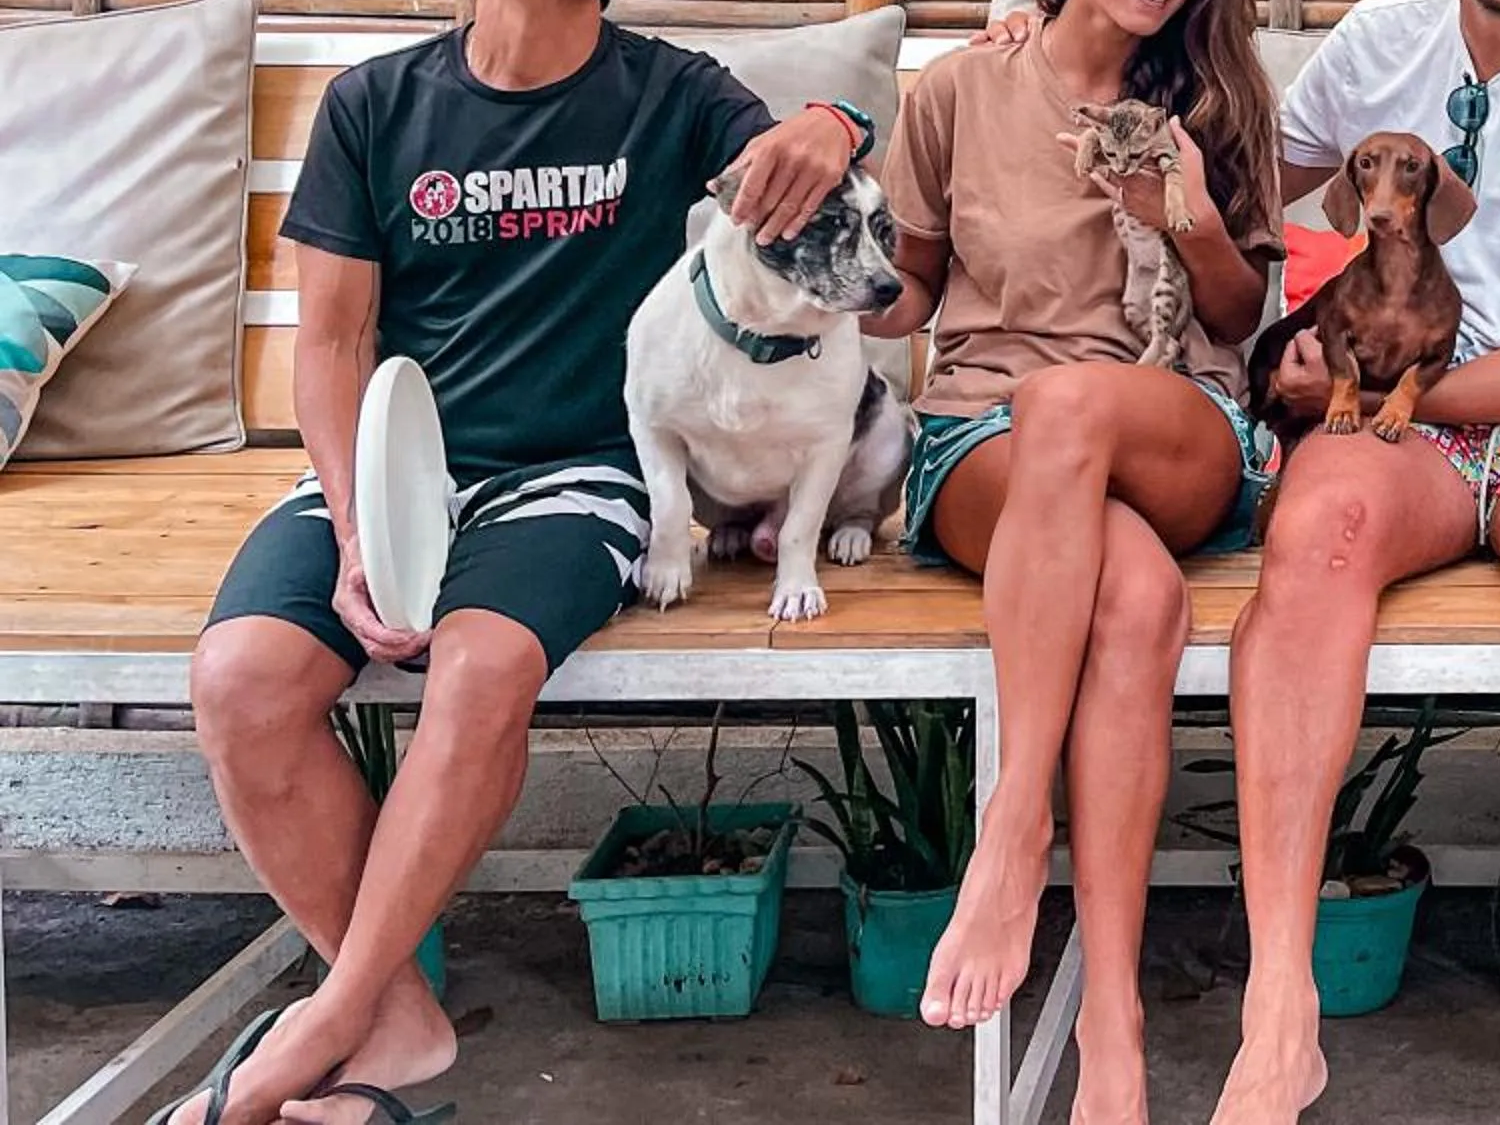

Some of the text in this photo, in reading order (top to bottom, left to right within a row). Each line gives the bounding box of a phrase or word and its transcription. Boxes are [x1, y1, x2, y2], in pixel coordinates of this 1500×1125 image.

[464, 157, 628, 214] SPARTAN
[411, 199, 621, 245] 2018 SPRINT
